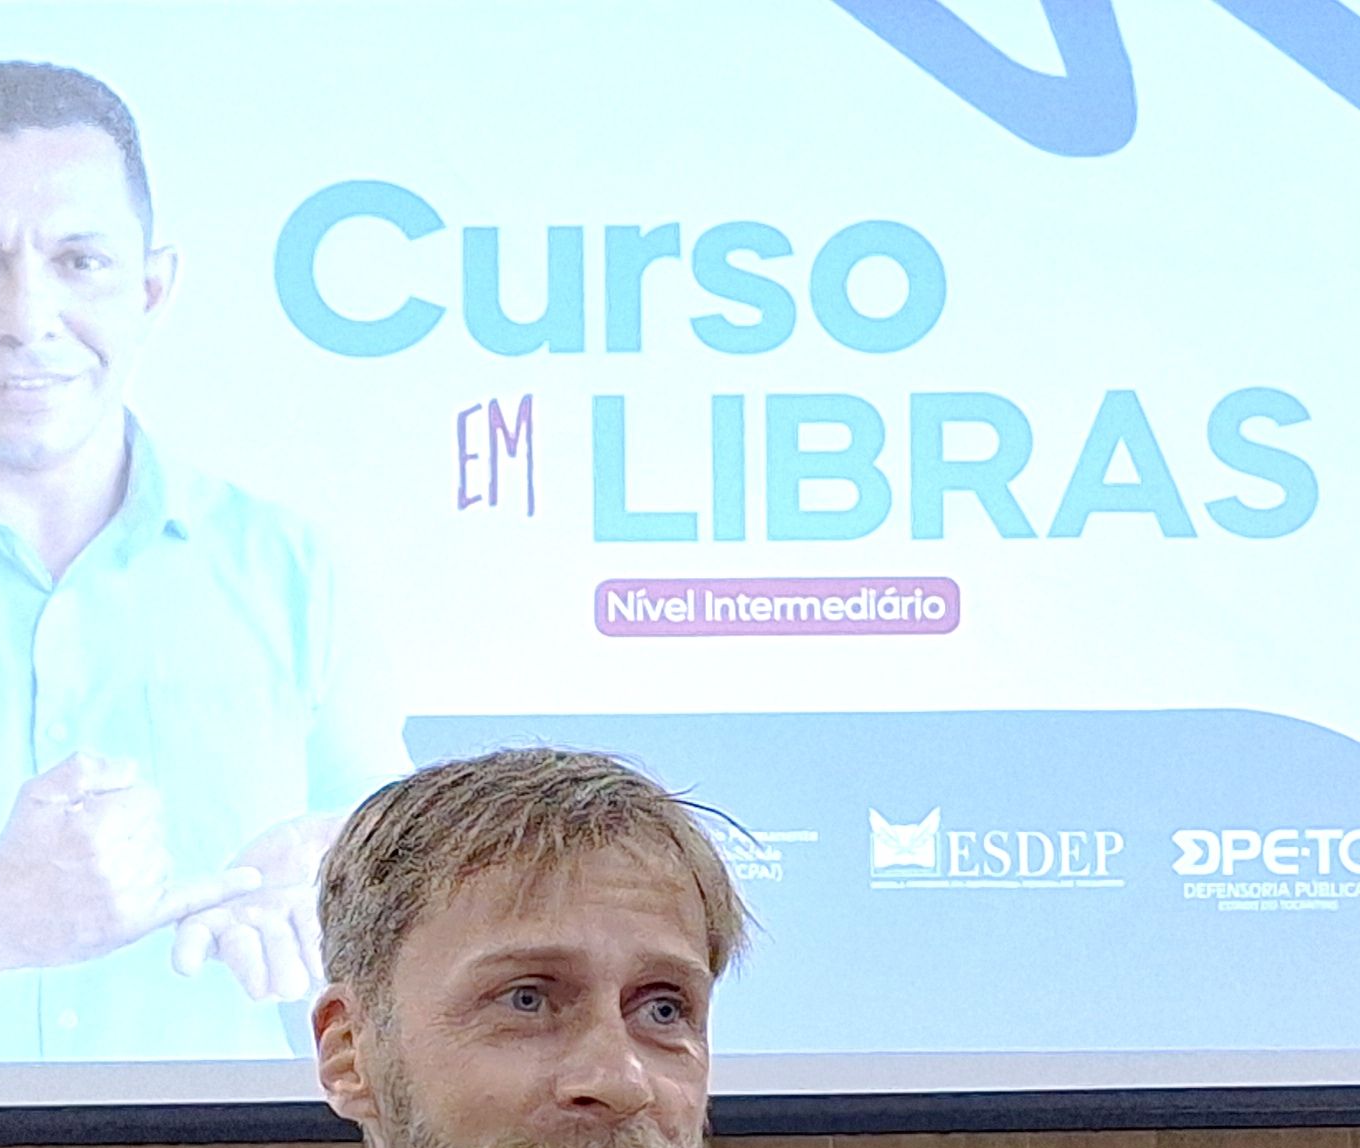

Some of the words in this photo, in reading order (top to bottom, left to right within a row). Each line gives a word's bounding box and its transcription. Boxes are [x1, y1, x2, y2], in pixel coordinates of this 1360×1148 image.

[273, 179, 948, 358] Curso
[456, 393, 535, 517] EM
[591, 386, 1320, 543] LIBRAS
[606, 588, 695, 622] Nível
[704, 586, 947, 622] Intermediário
[946, 830, 1125, 877] ESDEP
[1183, 882, 1291, 899] DEFENSORIA
